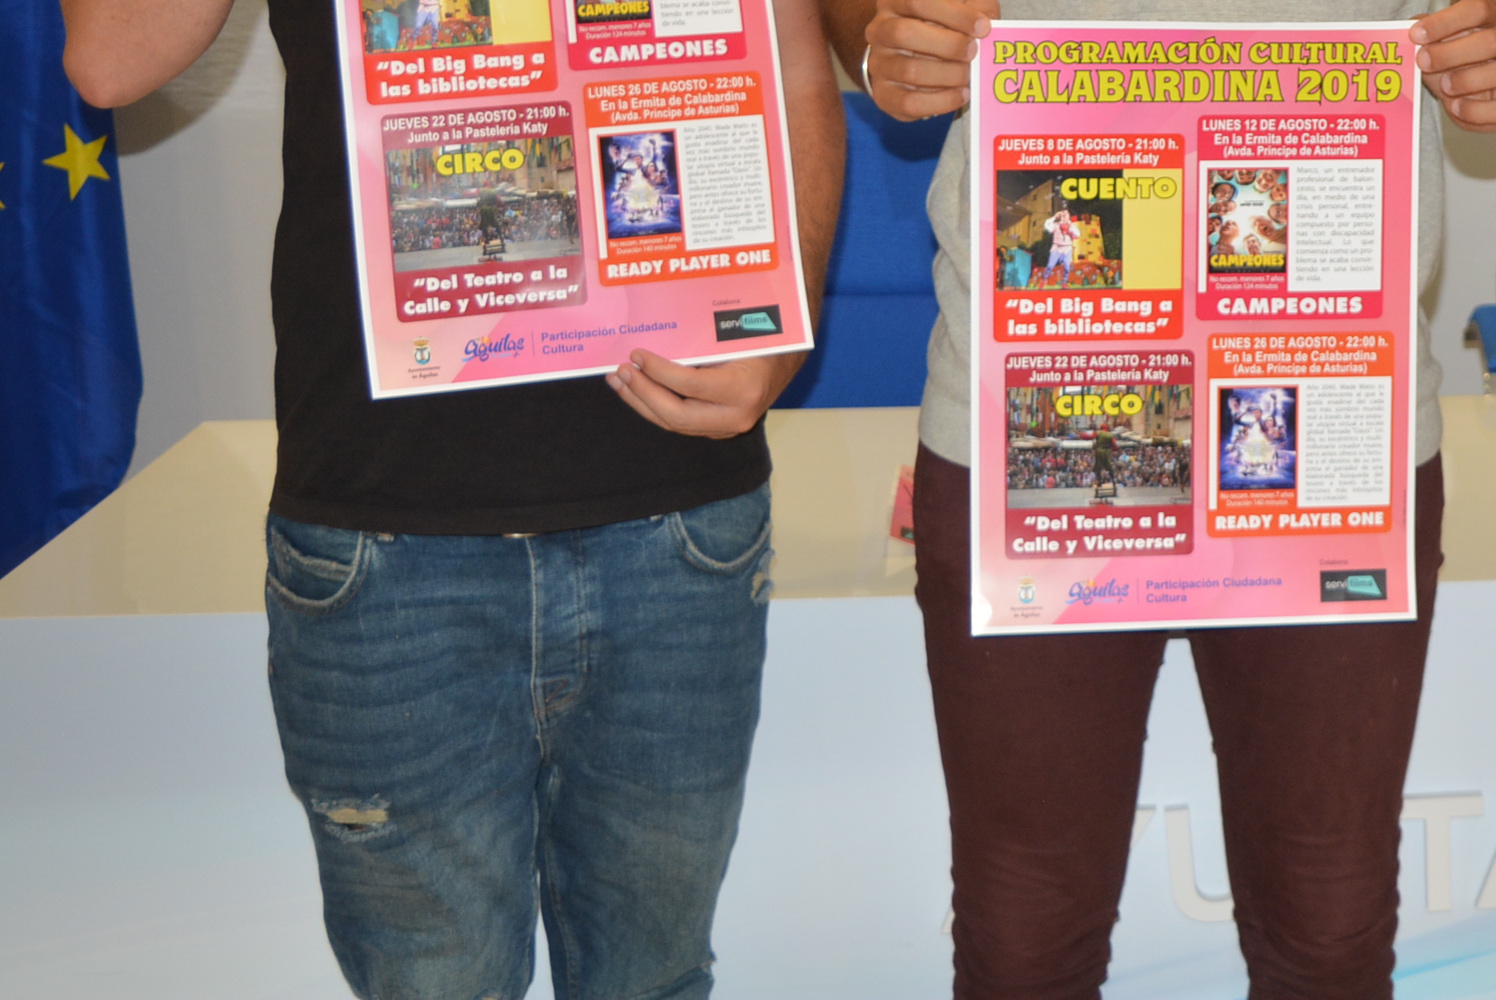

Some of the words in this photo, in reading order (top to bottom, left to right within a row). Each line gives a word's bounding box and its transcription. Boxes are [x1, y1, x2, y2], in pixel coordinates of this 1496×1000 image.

[577, 0, 650, 18] CAMPEONES
[589, 38, 728, 64] CAMPEONES
[994, 36, 1242, 64] PROGRAMACIÓN
[1249, 42, 1403, 65] CULTURAL
[432, 55, 466, 75] Big
[472, 54, 525, 71] Bang
[532, 53, 545, 65] a
[380, 82, 411, 99] las
[993, 69, 1284, 104] CALABARDINA
[1295, 68, 1402, 105] 2019
[434, 147, 526, 177] CIRCO
[1061, 176, 1177, 200] CUENTO
[606, 259, 663, 279] READY
[669, 253, 731, 272] PLAYER
[736, 248, 772, 265] ONE
[1210, 254, 1285, 268] CAMPEONES
[463, 271, 524, 288] Teatro
[530, 270, 543, 281] a
[548, 264, 568, 280] la
[402, 297, 451, 316] Calle
[457, 298, 469, 314] y
[1060, 297, 1094, 317] Big
[1101, 297, 1152, 317] Bang
[1159, 300, 1172, 312] a
[1217, 296, 1363, 315] CAMPEONES
[541, 326, 616, 345] Participación
[618, 320, 679, 334] Ciudadana
[1008, 319, 1038, 335] las
[543, 344, 585, 356] Cultura
[1055, 393, 1144, 417] CIRCO
[1073, 515, 1133, 530] Teatro
[1139, 517, 1151, 528] a
[1158, 512, 1176, 527] la
[1215, 514, 1273, 530] READY
[1279, 513, 1342, 528] PLAYER
[1348, 511, 1384, 526] ONE
[1012, 536, 1059, 553] Calle
[1066, 540, 1077, 555] y
[1146, 578, 1219, 592] Participación
[1223, 576, 1282, 586] Ciudadana
[1146, 594, 1187, 603] Cultura
